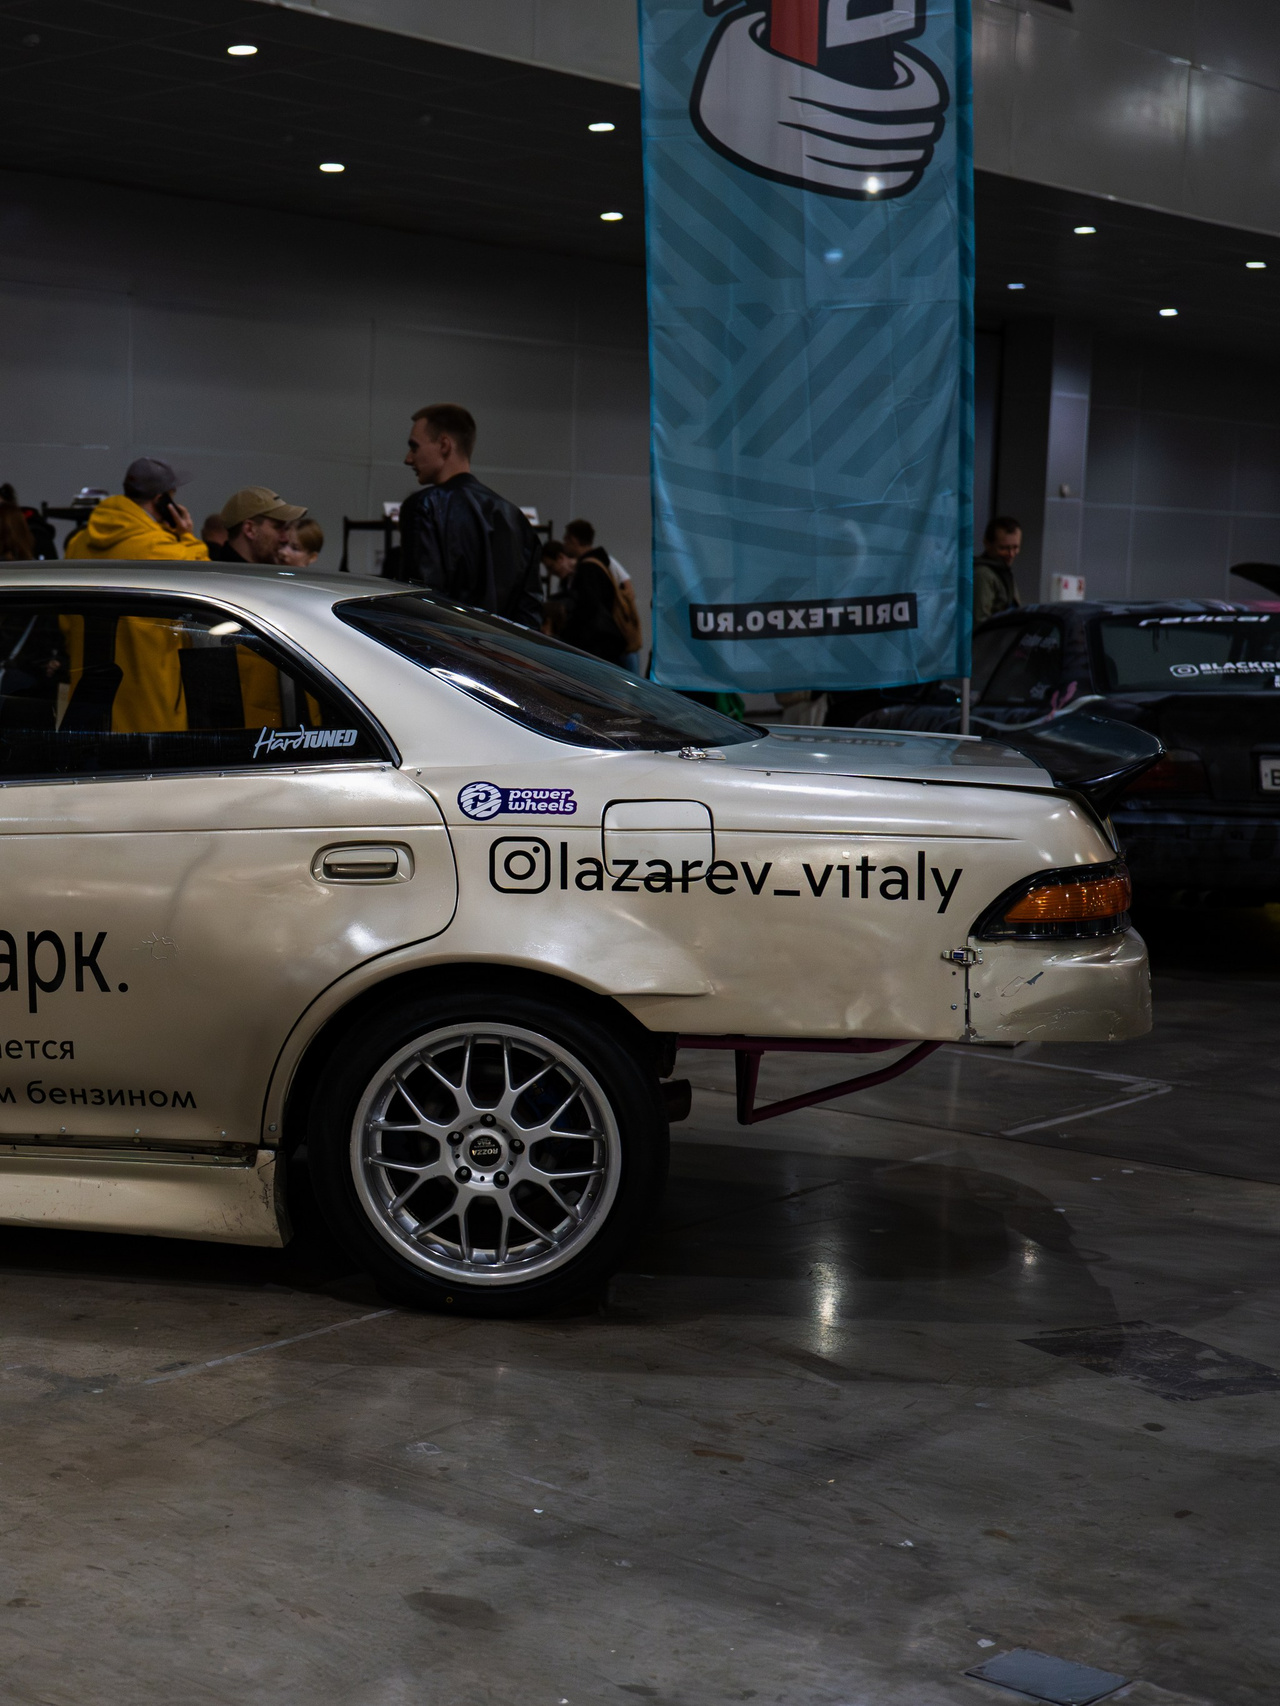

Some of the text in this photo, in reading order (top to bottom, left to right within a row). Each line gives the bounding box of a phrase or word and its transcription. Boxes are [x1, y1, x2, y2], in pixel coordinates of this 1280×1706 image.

[1199, 661, 1280, 670] BLACKD
[508, 790, 571, 801] power
[508, 800, 575, 812] wheels
[560, 841, 963, 914] lazarev_vitaly
[26, 1080, 198, 1109] бензином
